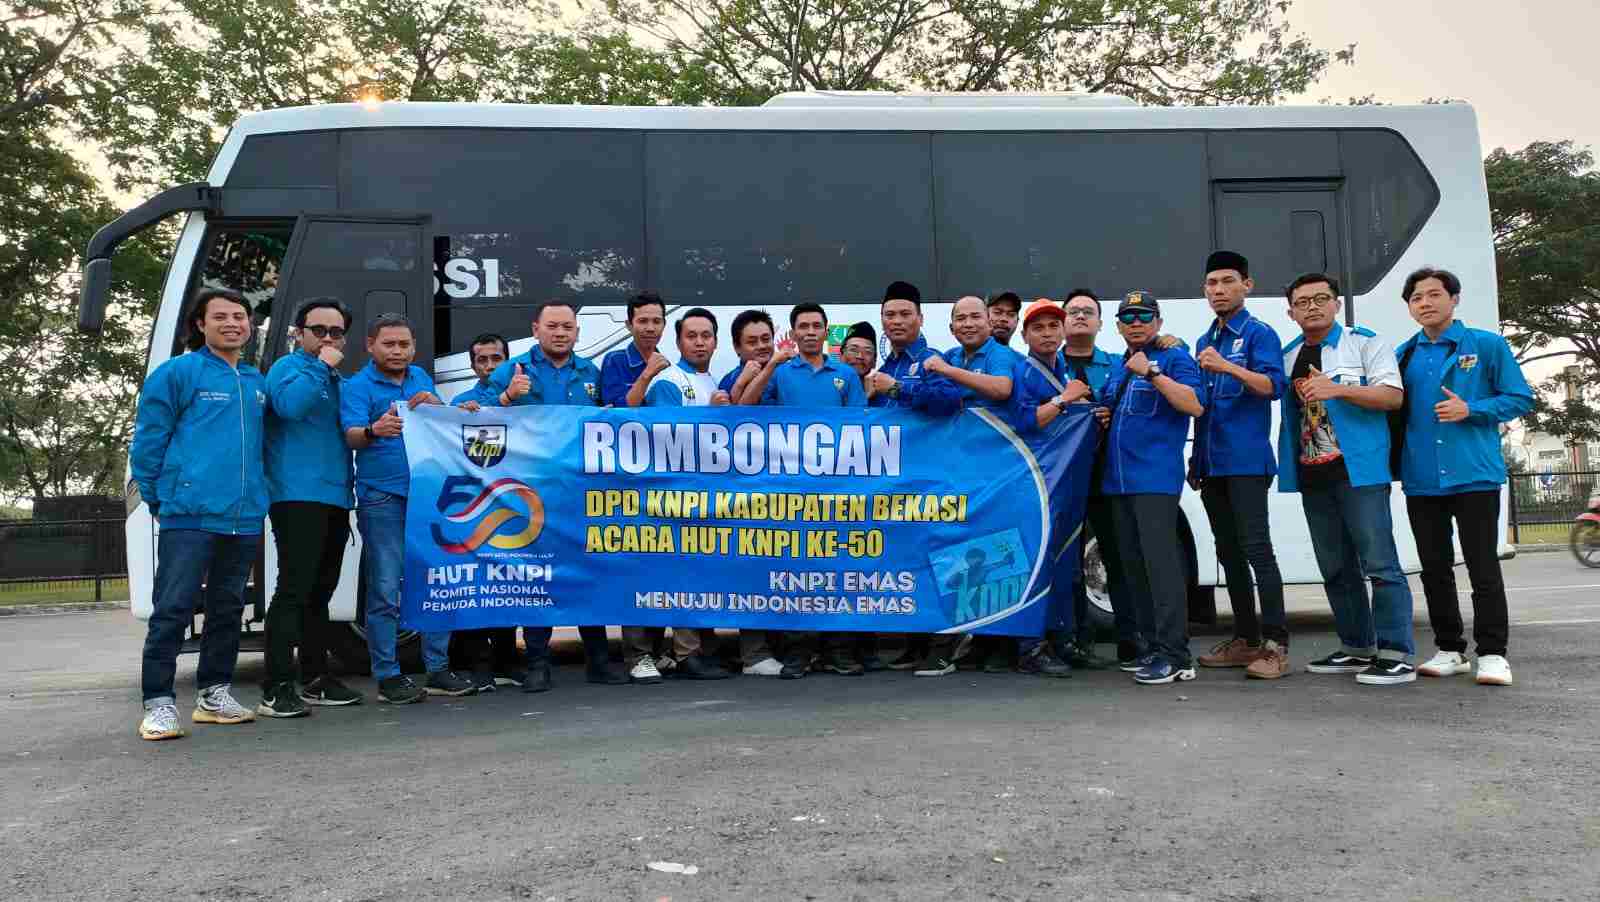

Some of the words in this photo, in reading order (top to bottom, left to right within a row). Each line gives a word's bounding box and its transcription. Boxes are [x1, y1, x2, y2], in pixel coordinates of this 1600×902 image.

[583, 421, 902, 477] ROMBONGAN
[585, 490, 640, 518] DPD
[646, 490, 709, 520] KNPI
[714, 492, 866, 522] KABUPATEN
[872, 494, 968, 522] BEKASI
[585, 524, 676, 554] ACARA
[680, 525, 734, 555] HUT
[737, 527, 800, 558] KNPI
[806, 529, 884, 558] KE-50
[427, 563, 480, 585] HUT
[486, 563, 554, 582] KNPI
[768, 570, 838, 593] KNPI
[843, 571, 917, 593] EMAS
[430, 585, 476, 599] KOMITE
[480, 584, 548, 596] NASIONAL
[635, 591, 722, 610] MENUJU
[727, 592, 850, 614] INDONESIA
[855, 594, 917, 615] EMAS
[422, 599, 477, 612] PEMUDA
[480, 597, 554, 609] INDONESIA
